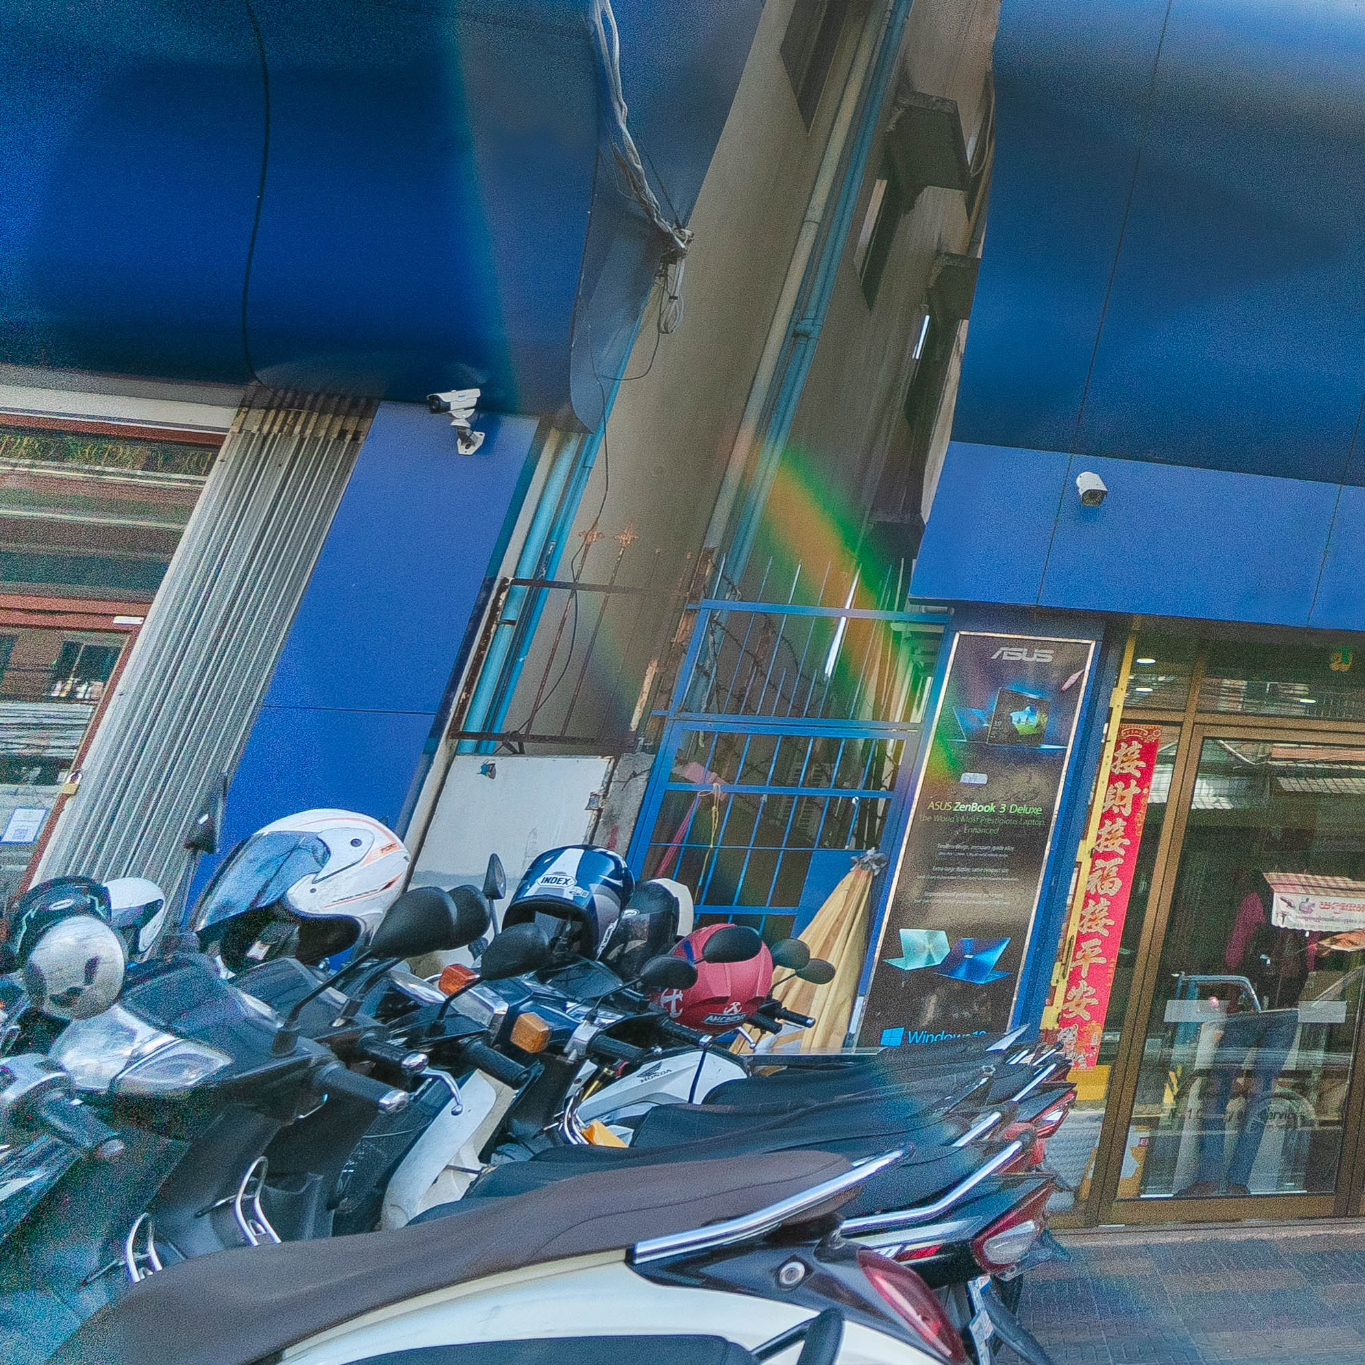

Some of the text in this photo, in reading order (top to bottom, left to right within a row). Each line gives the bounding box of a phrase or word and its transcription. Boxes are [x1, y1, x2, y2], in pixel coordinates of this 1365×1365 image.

[990, 646, 1055, 663] ASUS
[927, 801, 1043, 815] ASUS ZenBook 3 Deluxe
[540, 876, 571, 886] INDEX
[640, 1068, 672, 1083] HONDA
